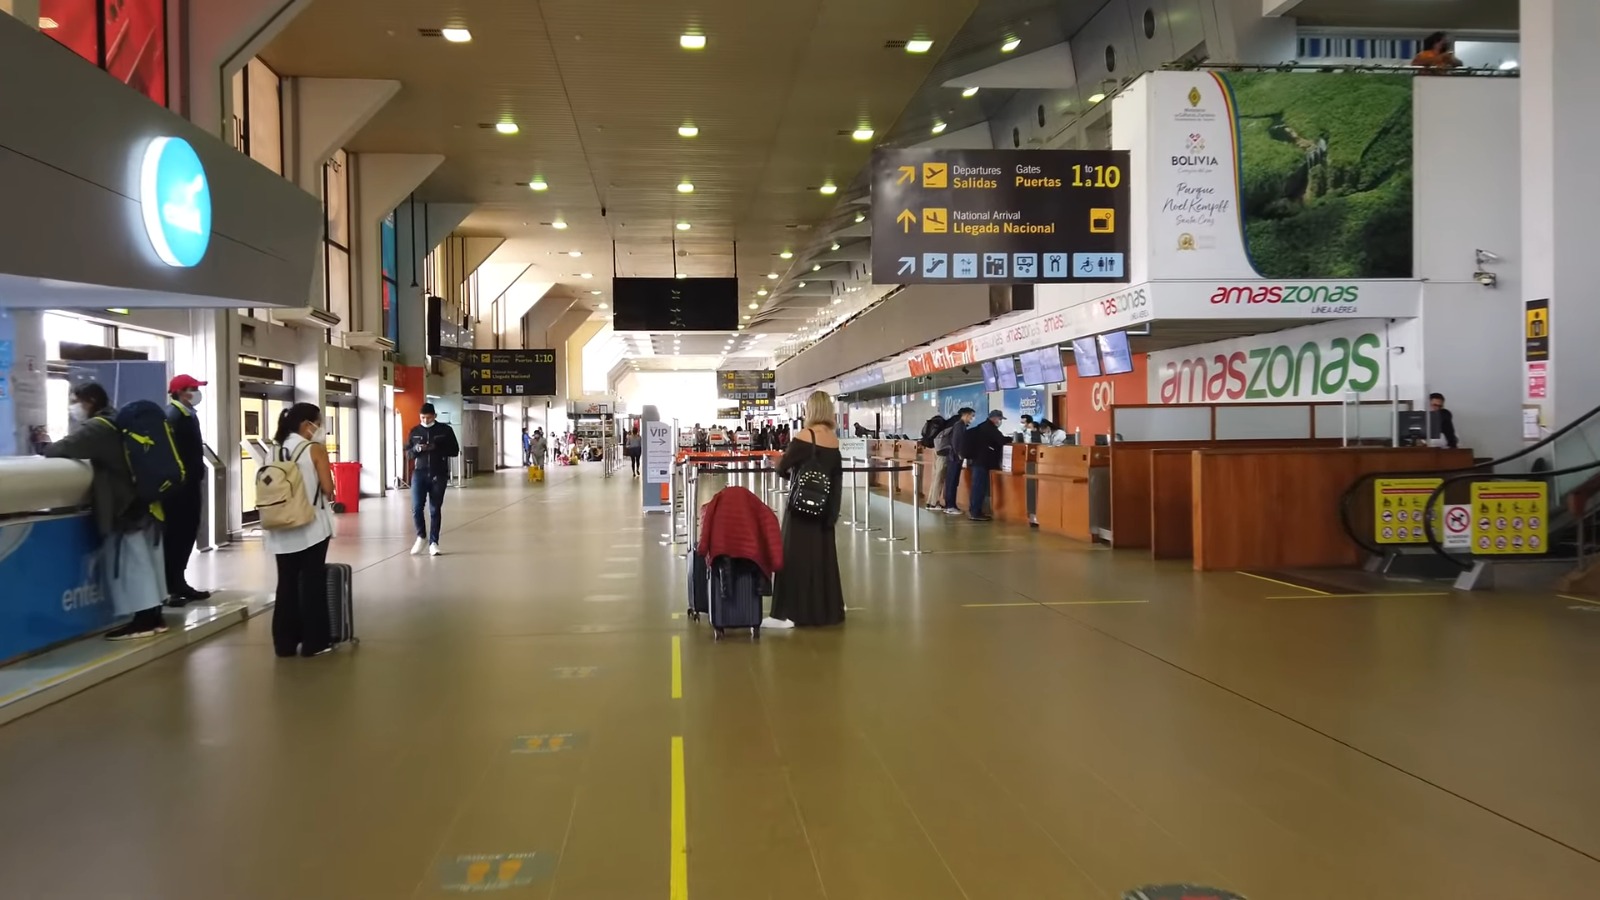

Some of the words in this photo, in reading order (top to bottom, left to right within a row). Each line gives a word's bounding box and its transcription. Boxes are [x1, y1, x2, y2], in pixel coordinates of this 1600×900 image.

[1171, 155, 1218, 166] BOLIVIA
[953, 164, 1002, 176] Departures
[1015, 164, 1041, 174] Gates
[1084, 164, 1093, 174] to
[953, 177, 998, 189] Salidas
[1015, 176, 1062, 188] Puertas
[1071, 164, 1083, 187] 1
[1085, 178, 1092, 187] a
[1094, 165, 1121, 188] 10
[1176, 182, 1215, 199] Parque
[1162, 199, 1187, 214] Noel
[1188, 198, 1230, 217] Kempff
[953, 211, 990, 220] National
[993, 211, 1021, 220] Arrival
[1176, 215, 1196, 226] Santa
[953, 223, 1000, 235] Llegada
[1003, 222, 1055, 234] Nacional
[1210, 285, 1359, 304] amaszonas
[1311, 305, 1332, 314] LÍNEA
[1333, 305, 1358, 314] AÉREA
[1160, 333, 1381, 404] amaszonas
[650, 428, 668, 437] VIP
